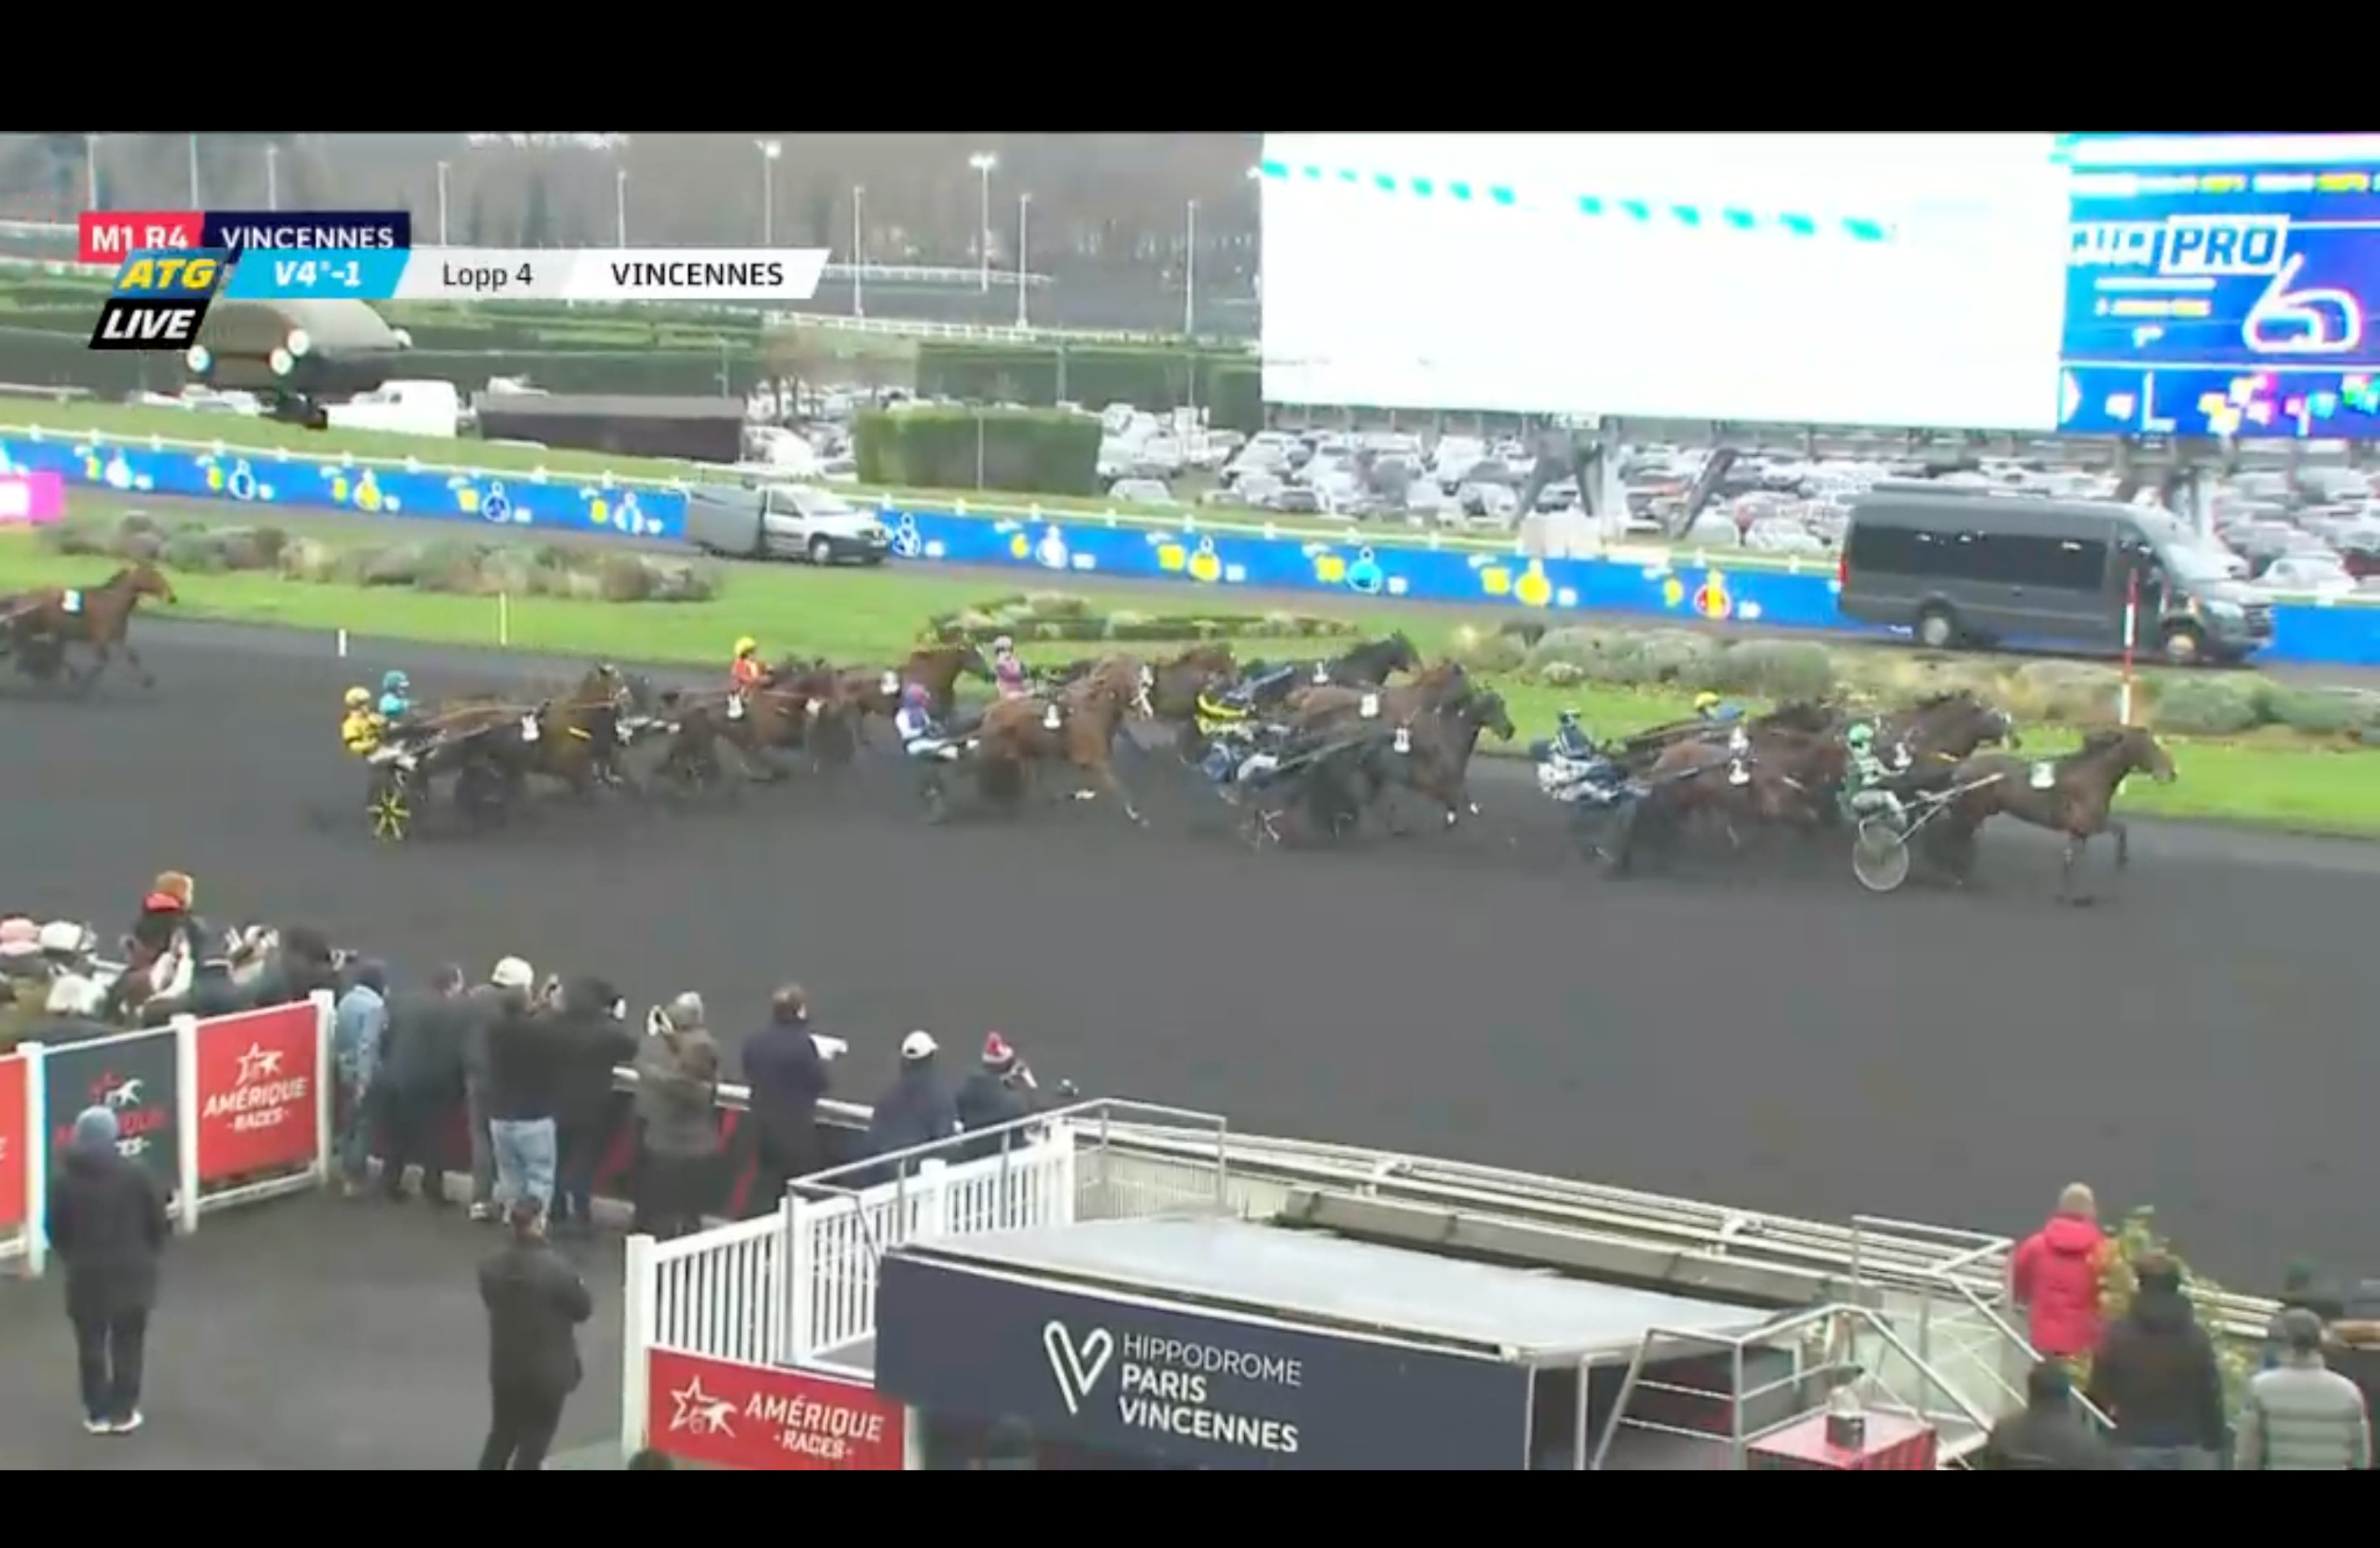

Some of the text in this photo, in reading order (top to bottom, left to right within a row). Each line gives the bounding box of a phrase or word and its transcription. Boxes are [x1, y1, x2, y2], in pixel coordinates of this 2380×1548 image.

[2170, 226, 2277, 267] PRO
[201, 1076, 308, 1119] AMÉRIQUE
[1121, 1362, 1208, 1404] PARIS
[1123, 1332, 1303, 1387] HIPPODROME
[744, 1391, 885, 1443] AMÉRIQUE
[1118, 1394, 1299, 1453] VINCENNES
